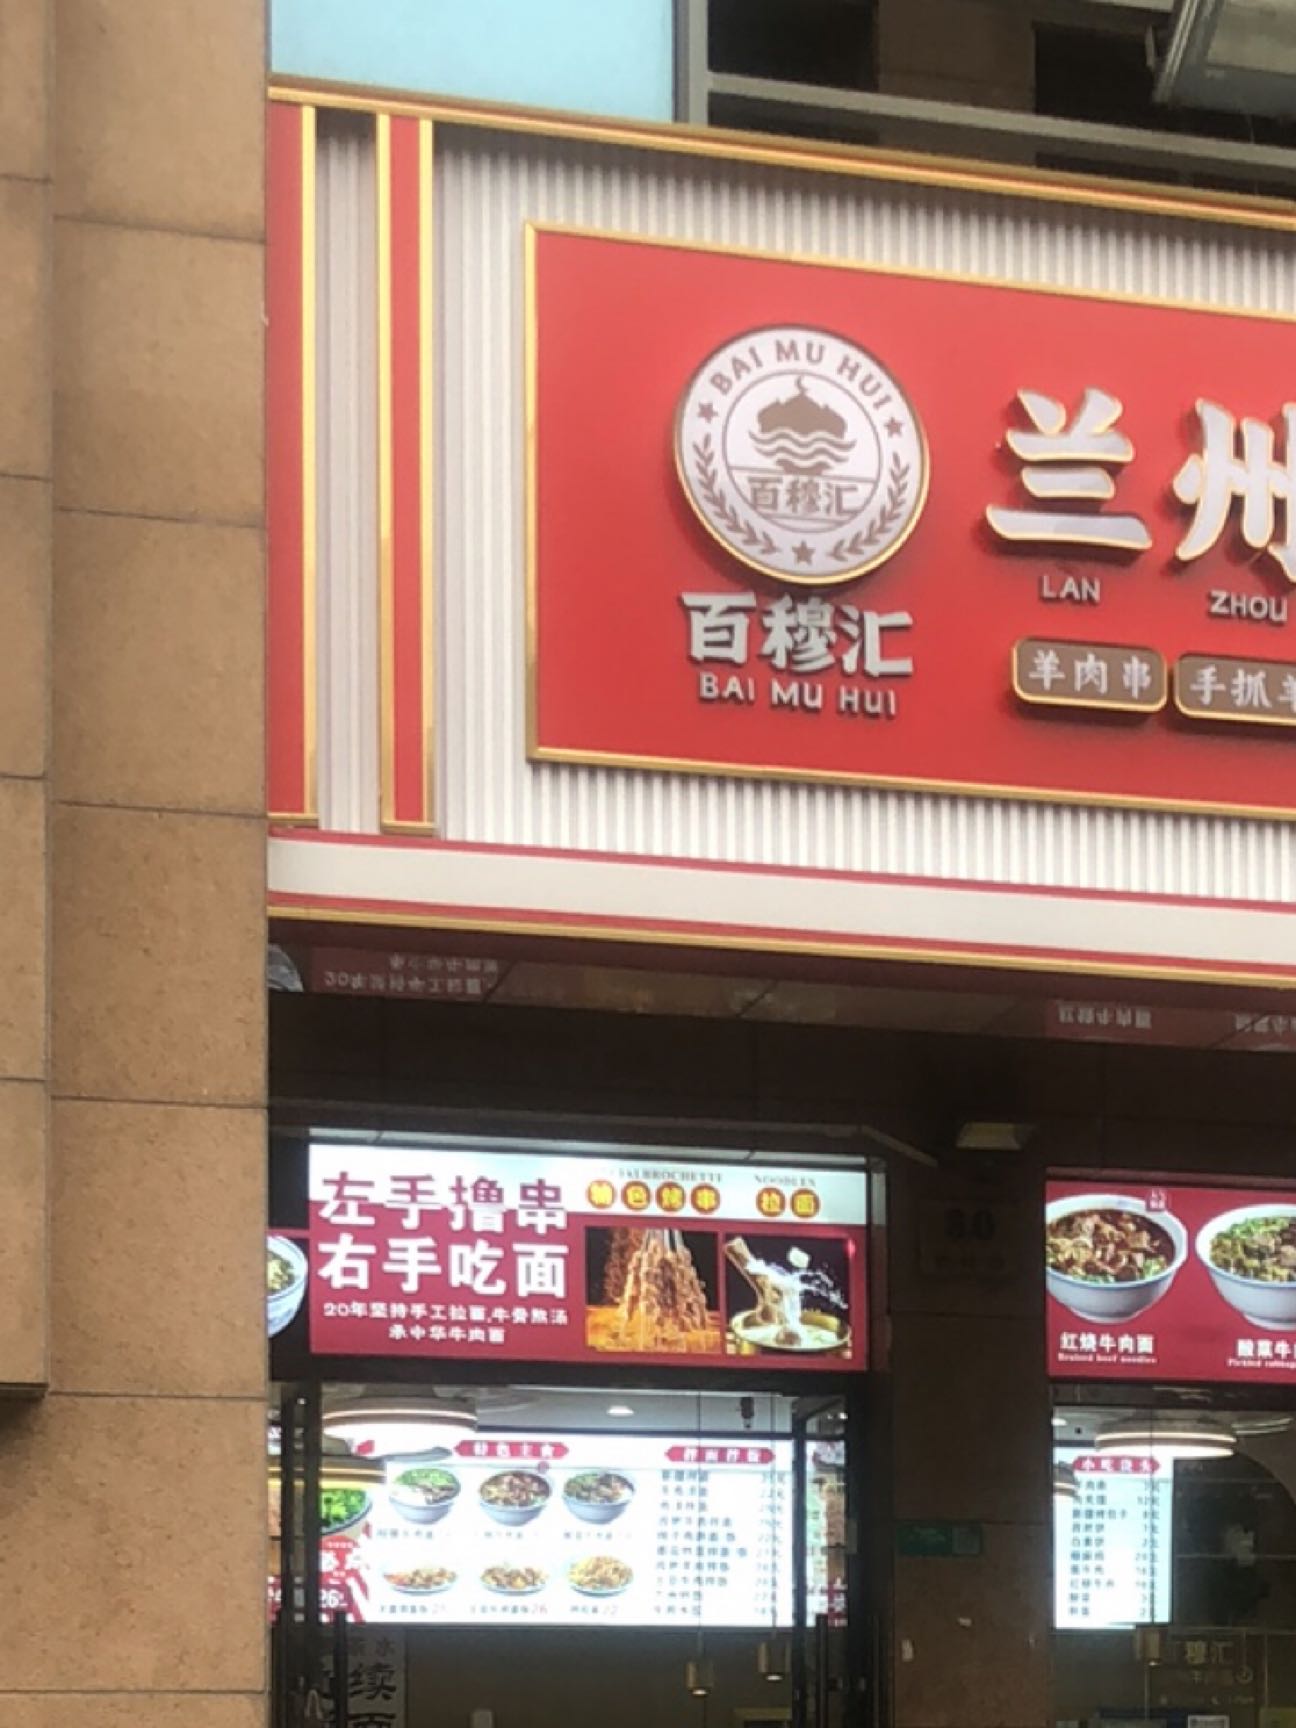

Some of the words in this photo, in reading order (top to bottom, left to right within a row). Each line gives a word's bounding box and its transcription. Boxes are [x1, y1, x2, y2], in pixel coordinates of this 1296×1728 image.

[710, 347, 763, 396] BAI
[775, 339, 825, 366] MU
[837, 359, 894, 410] HUI
[747, 476, 861, 515] 百穆汇
[1041, 574, 1101, 601] LAN
[1210, 590, 1288, 623] ZHOU
[681, 592, 913, 677] 百穆汇
[700, 673, 755, 702] BAI
[771, 681, 823, 710] MU
[839, 687, 897, 716] HUI
[1028, 647, 1154, 699] 羊肉串
[319, 1171, 569, 1234] 左手撸串
[318, 1233, 569, 1298] 右手吃面
[1060, 1332, 1155, 1355] 红烧牛肉面
